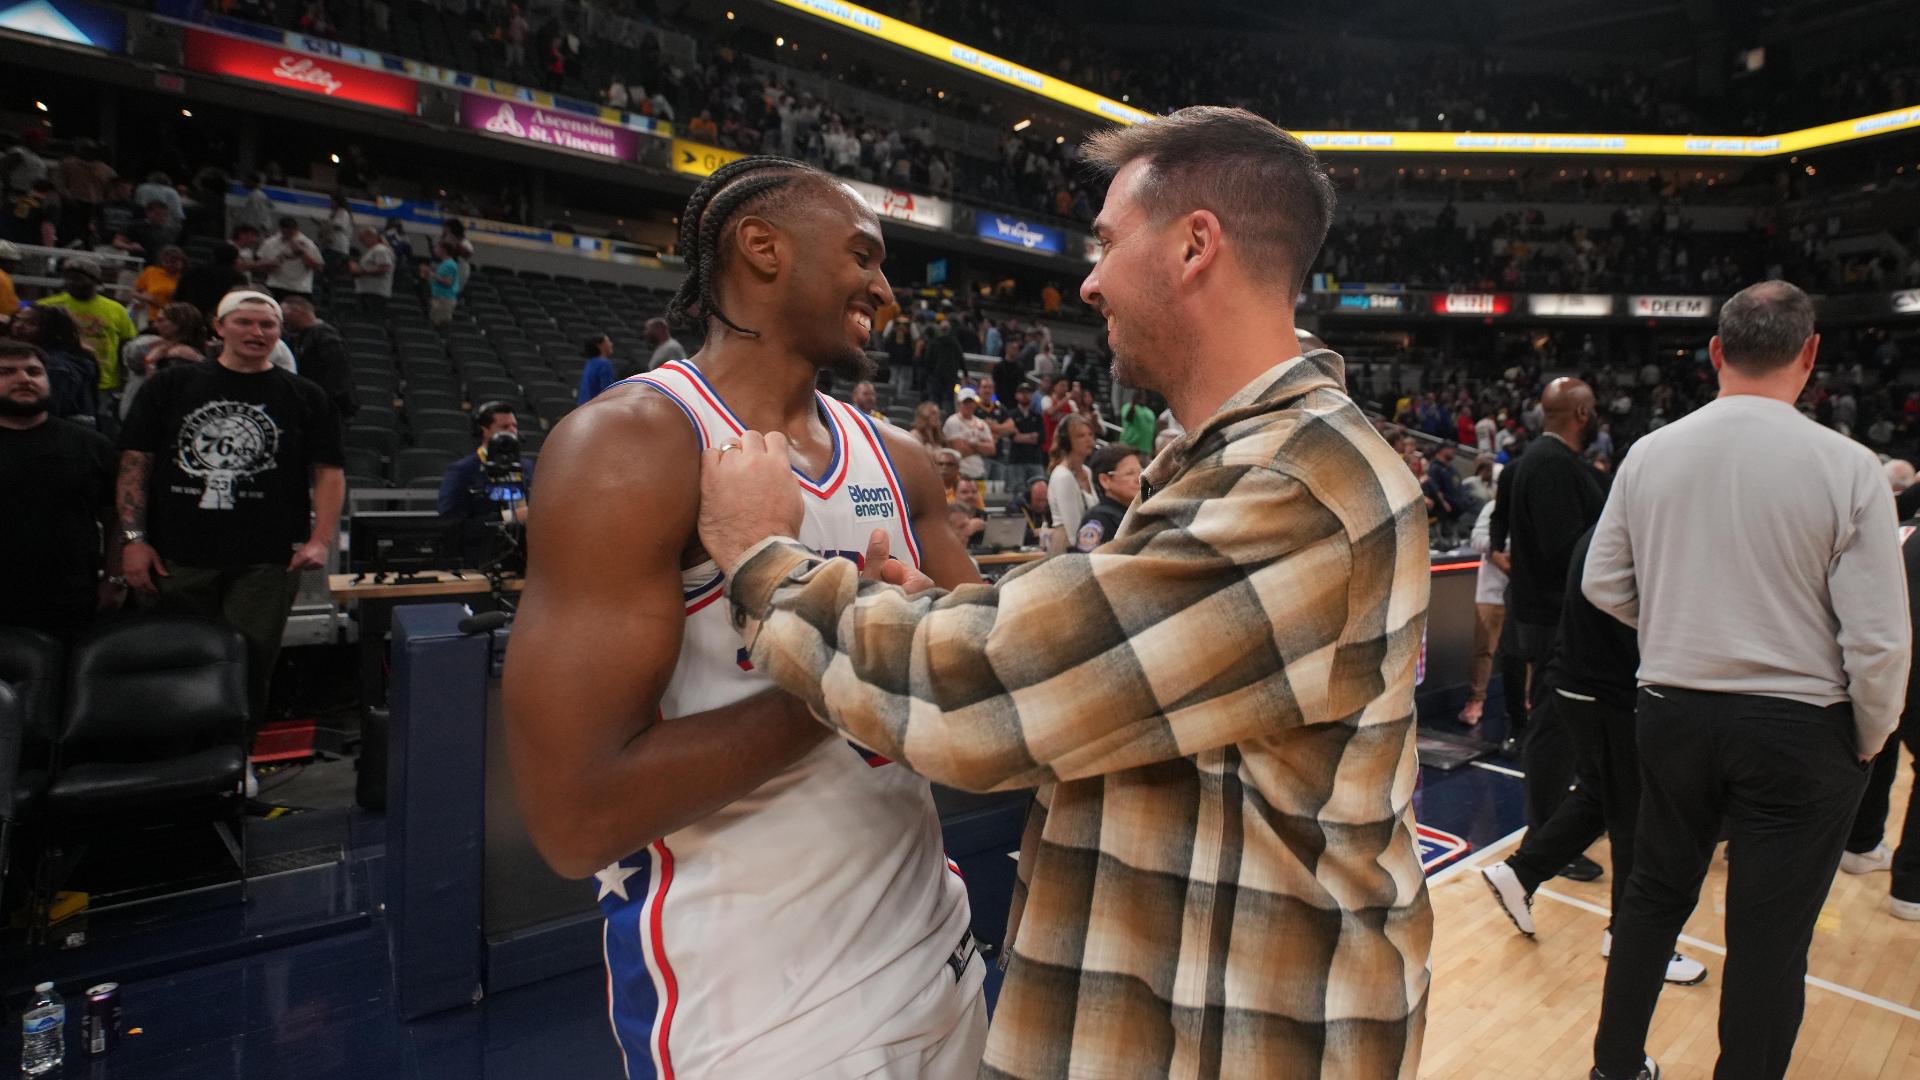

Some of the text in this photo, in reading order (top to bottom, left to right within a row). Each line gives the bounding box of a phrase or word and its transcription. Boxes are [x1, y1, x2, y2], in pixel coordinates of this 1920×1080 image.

[272, 56, 342, 95] Lilly
[531, 110, 614, 140] Ascension
[529, 125, 617, 157] St. Vincent
[1651, 300, 1702, 313] DEEM
[847, 484, 892, 503] Bloom
[854, 502, 894, 518] energy
